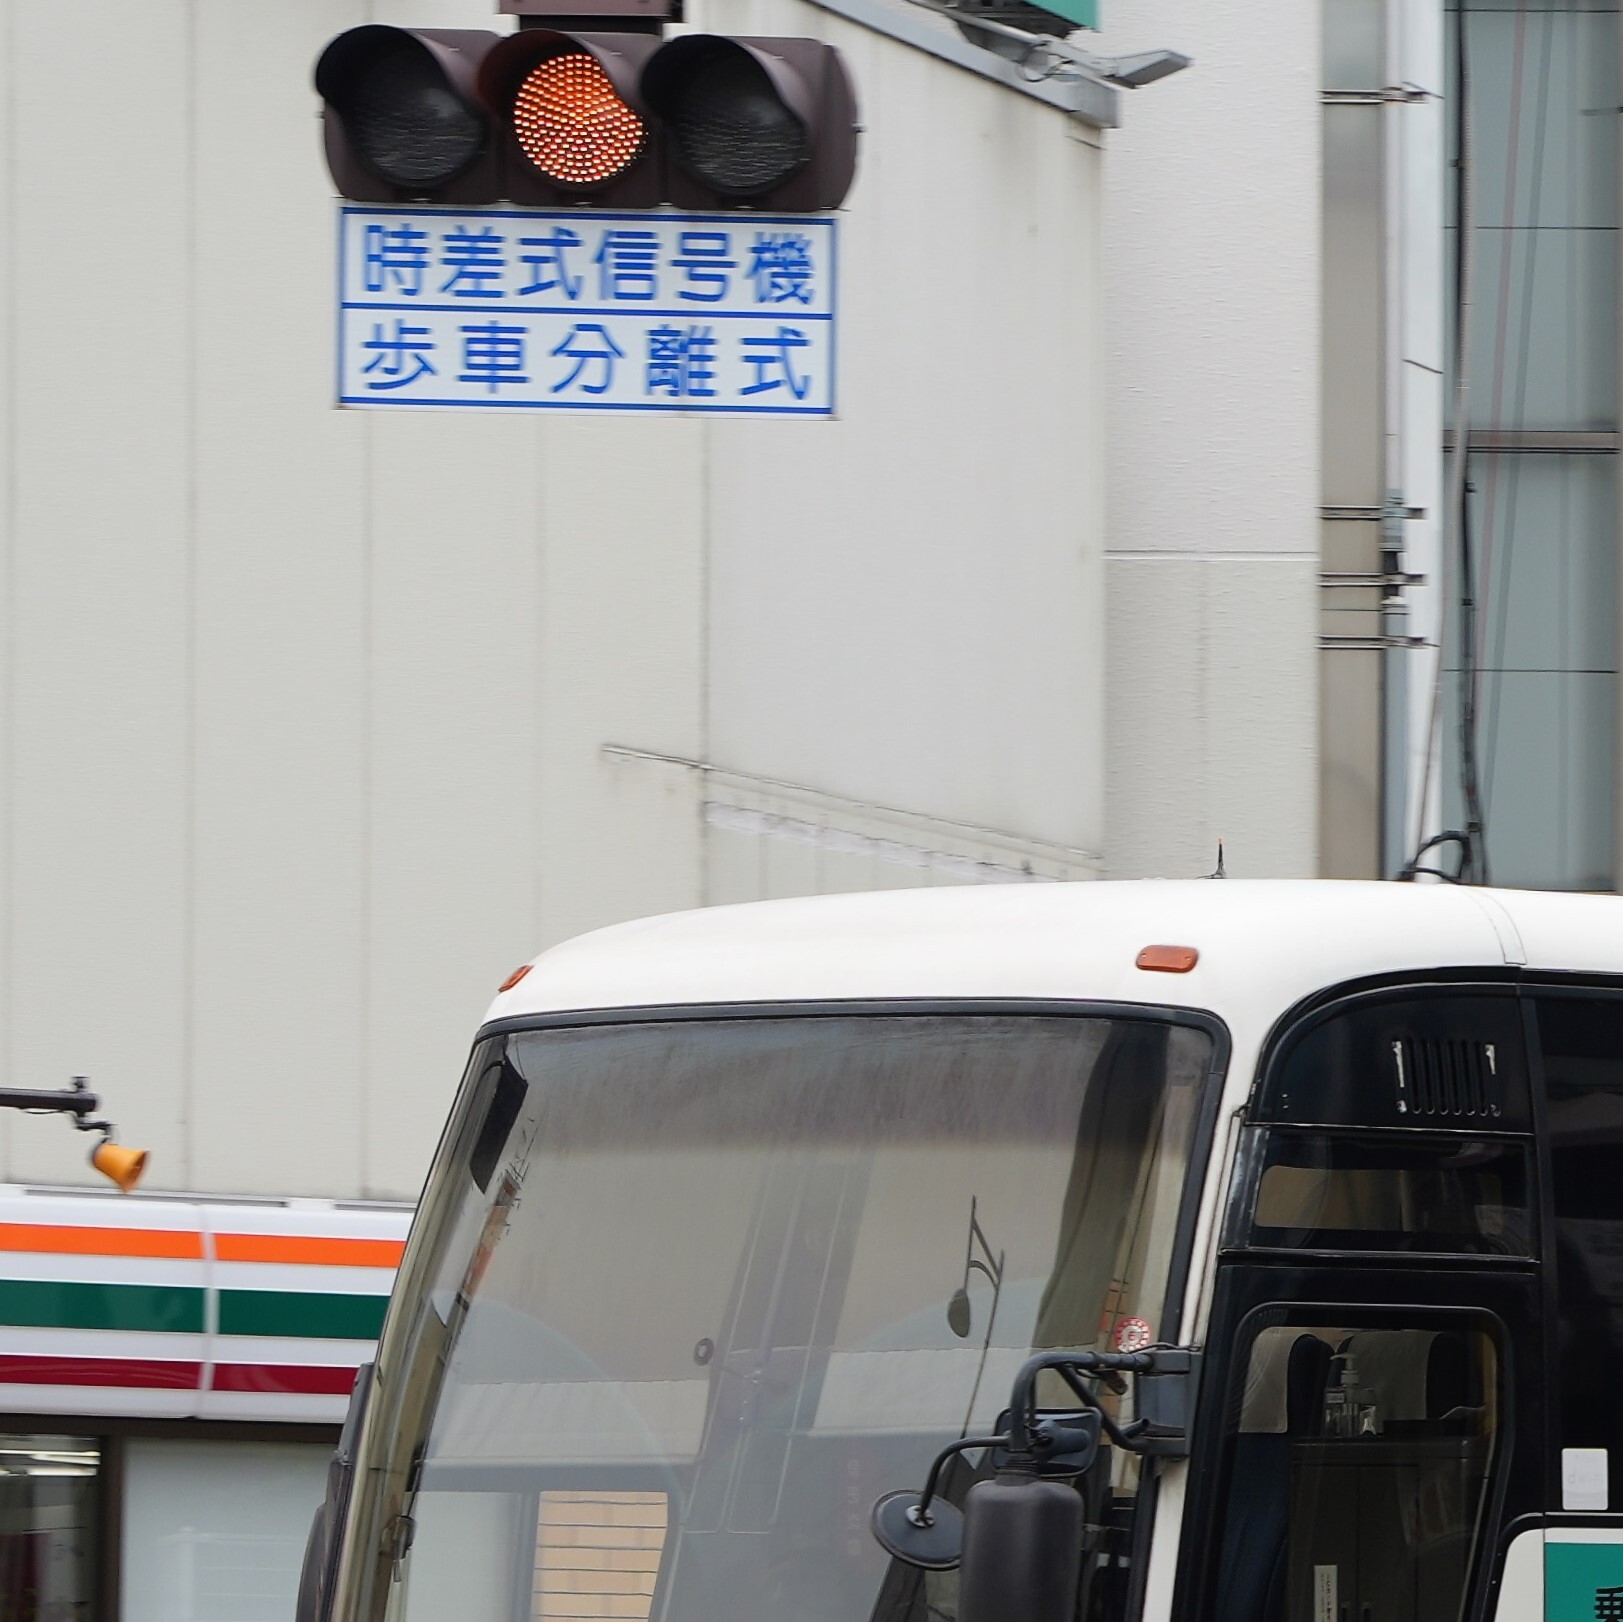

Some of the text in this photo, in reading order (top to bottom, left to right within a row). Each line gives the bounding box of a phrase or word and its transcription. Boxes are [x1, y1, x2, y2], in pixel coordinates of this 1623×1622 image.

[362, 224, 816, 306] 時差式信号機
[361, 319, 809, 402] 歩車分離式
